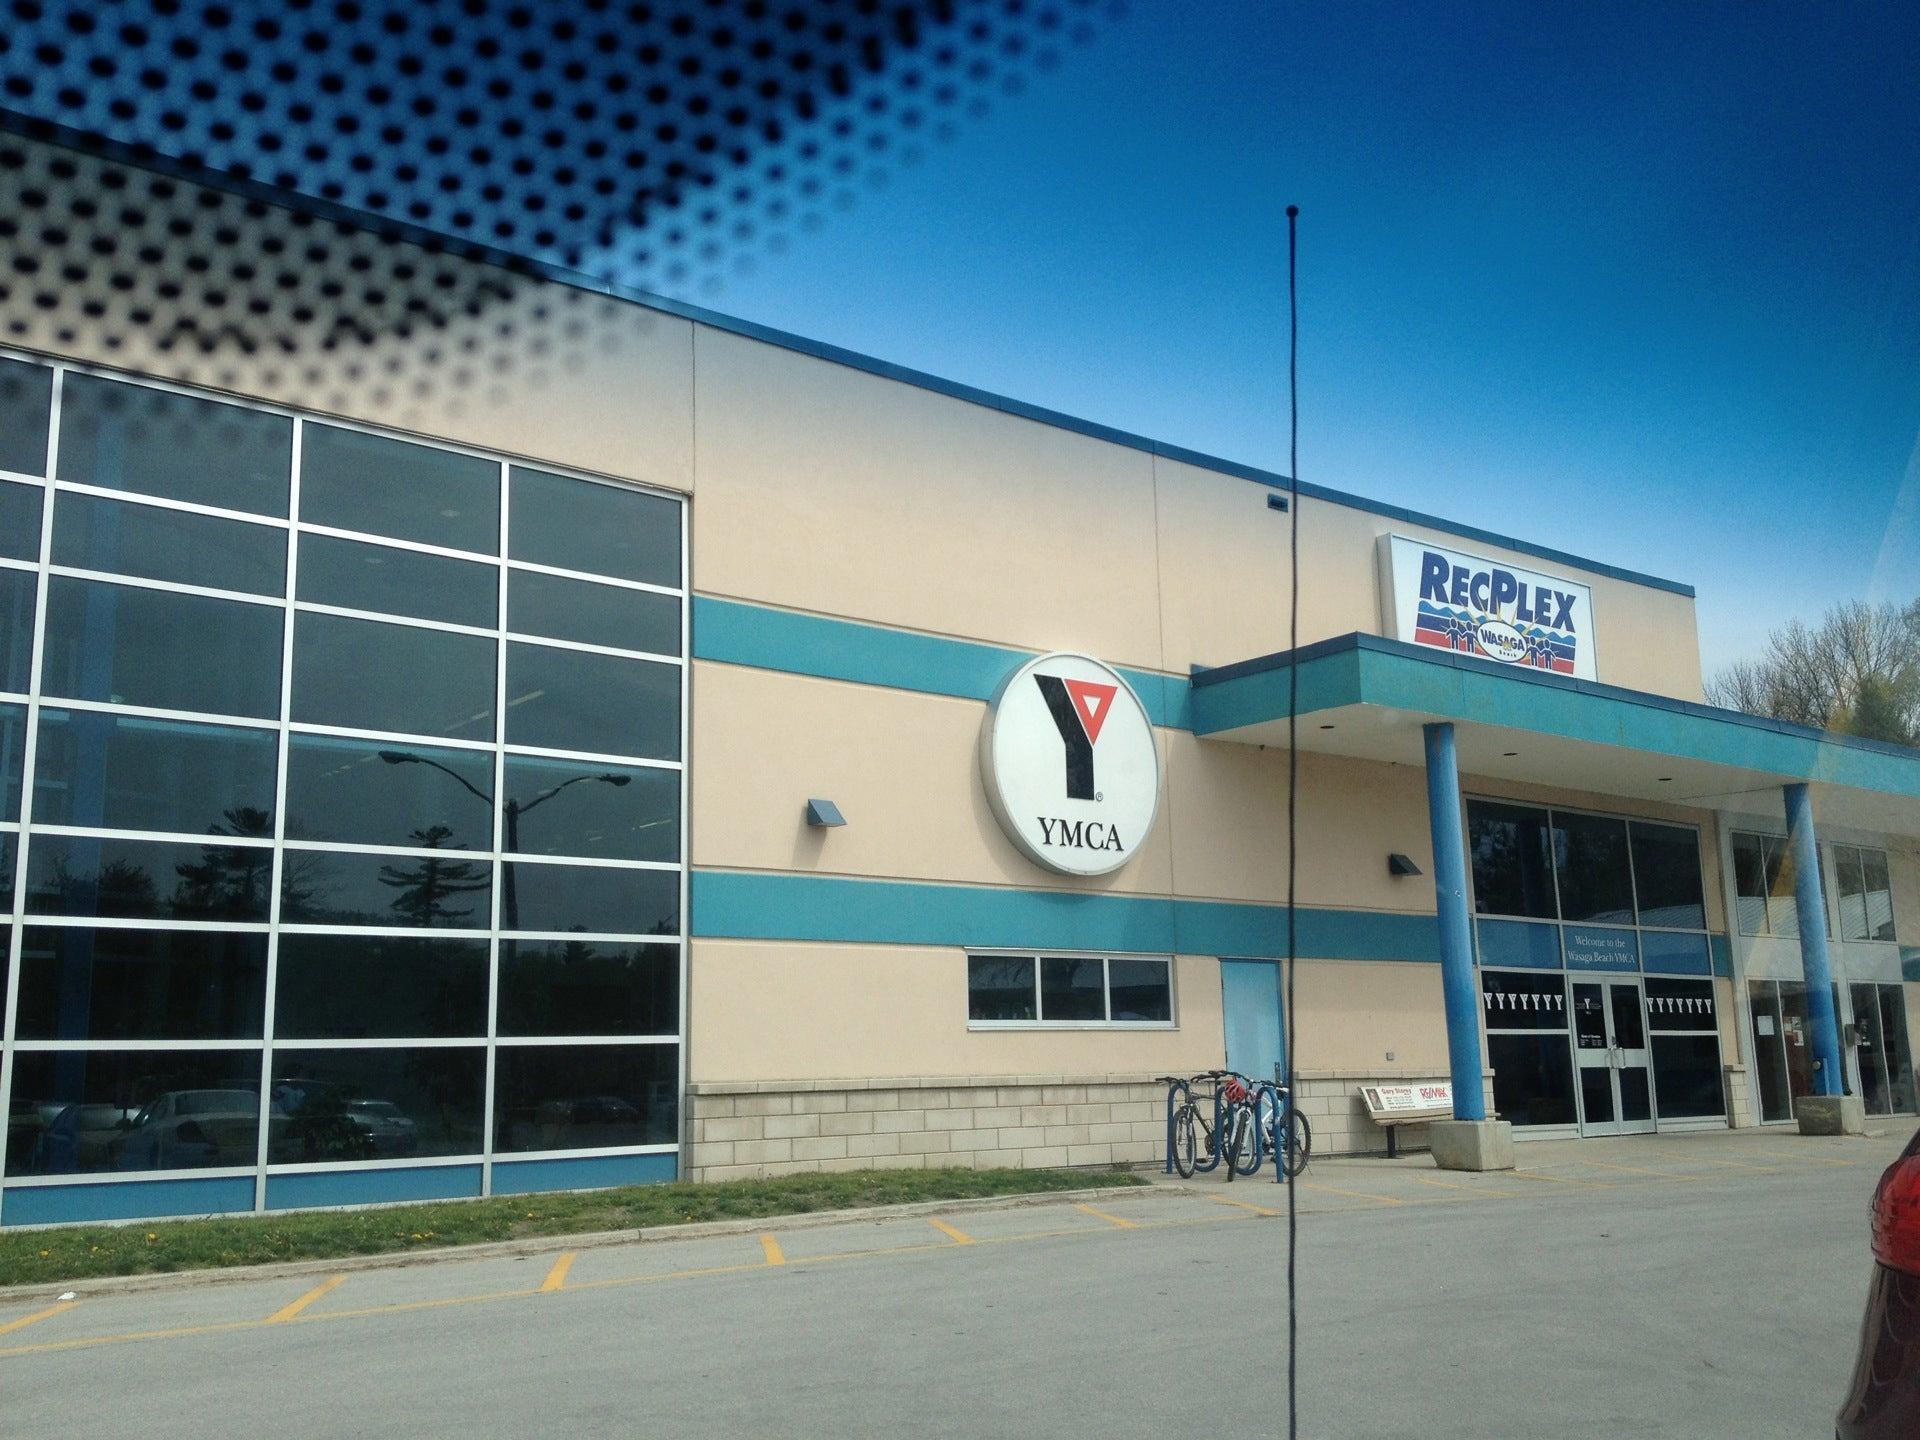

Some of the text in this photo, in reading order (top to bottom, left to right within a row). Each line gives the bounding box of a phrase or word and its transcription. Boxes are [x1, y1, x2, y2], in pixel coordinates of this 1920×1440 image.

[1480, 629, 1525, 651] WASAGA
[1037, 816, 1124, 851] YMCA
[1574, 935, 1626, 948] Welcome to the
[1567, 950, 1636, 964] Wasaga Beach YMCA
